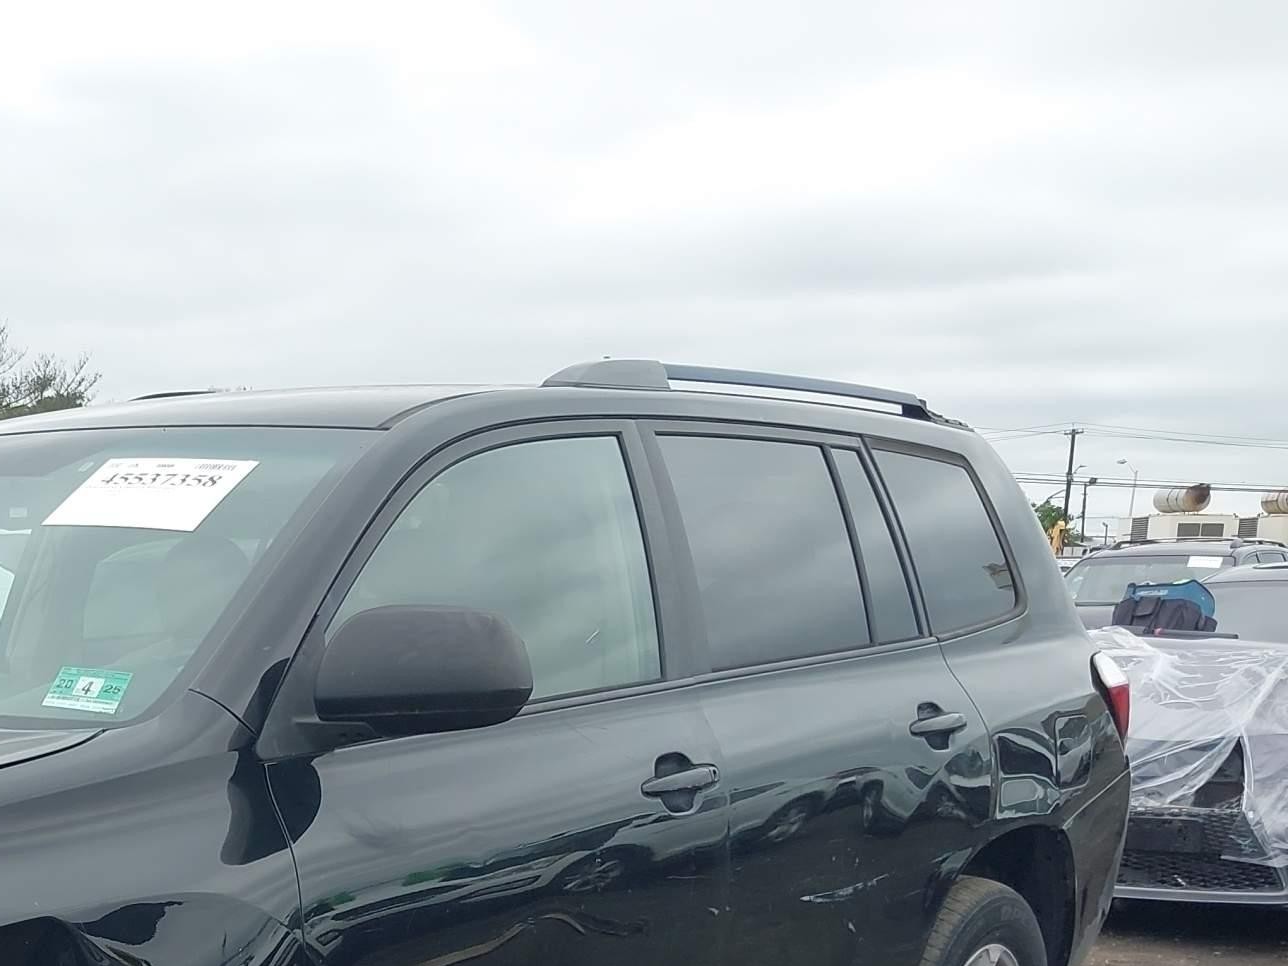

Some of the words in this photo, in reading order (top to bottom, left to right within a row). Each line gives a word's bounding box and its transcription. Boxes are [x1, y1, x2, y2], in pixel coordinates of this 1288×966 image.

[101, 473, 223, 488] 45537358
[56, 679, 74, 689] 20
[81, 681, 94, 696] 4
[102, 684, 121, 695] 25
